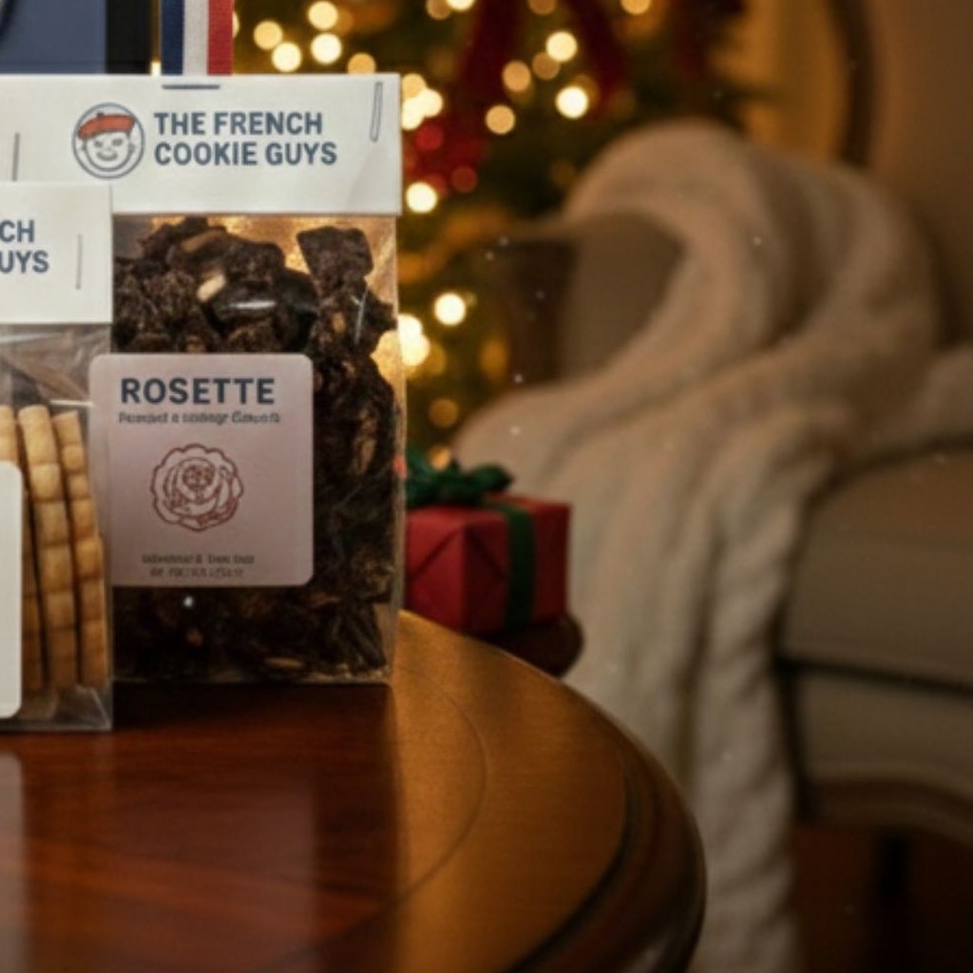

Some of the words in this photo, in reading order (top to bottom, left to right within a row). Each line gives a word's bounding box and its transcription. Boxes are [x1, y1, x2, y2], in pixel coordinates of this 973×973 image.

[154, 112, 206, 135] THE
[214, 111, 323, 135] FRENCH
[154, 142, 257, 166] COOKIE
[265, 141, 337, 166] GUYS
[121, 378, 275, 404] ROSETTE
